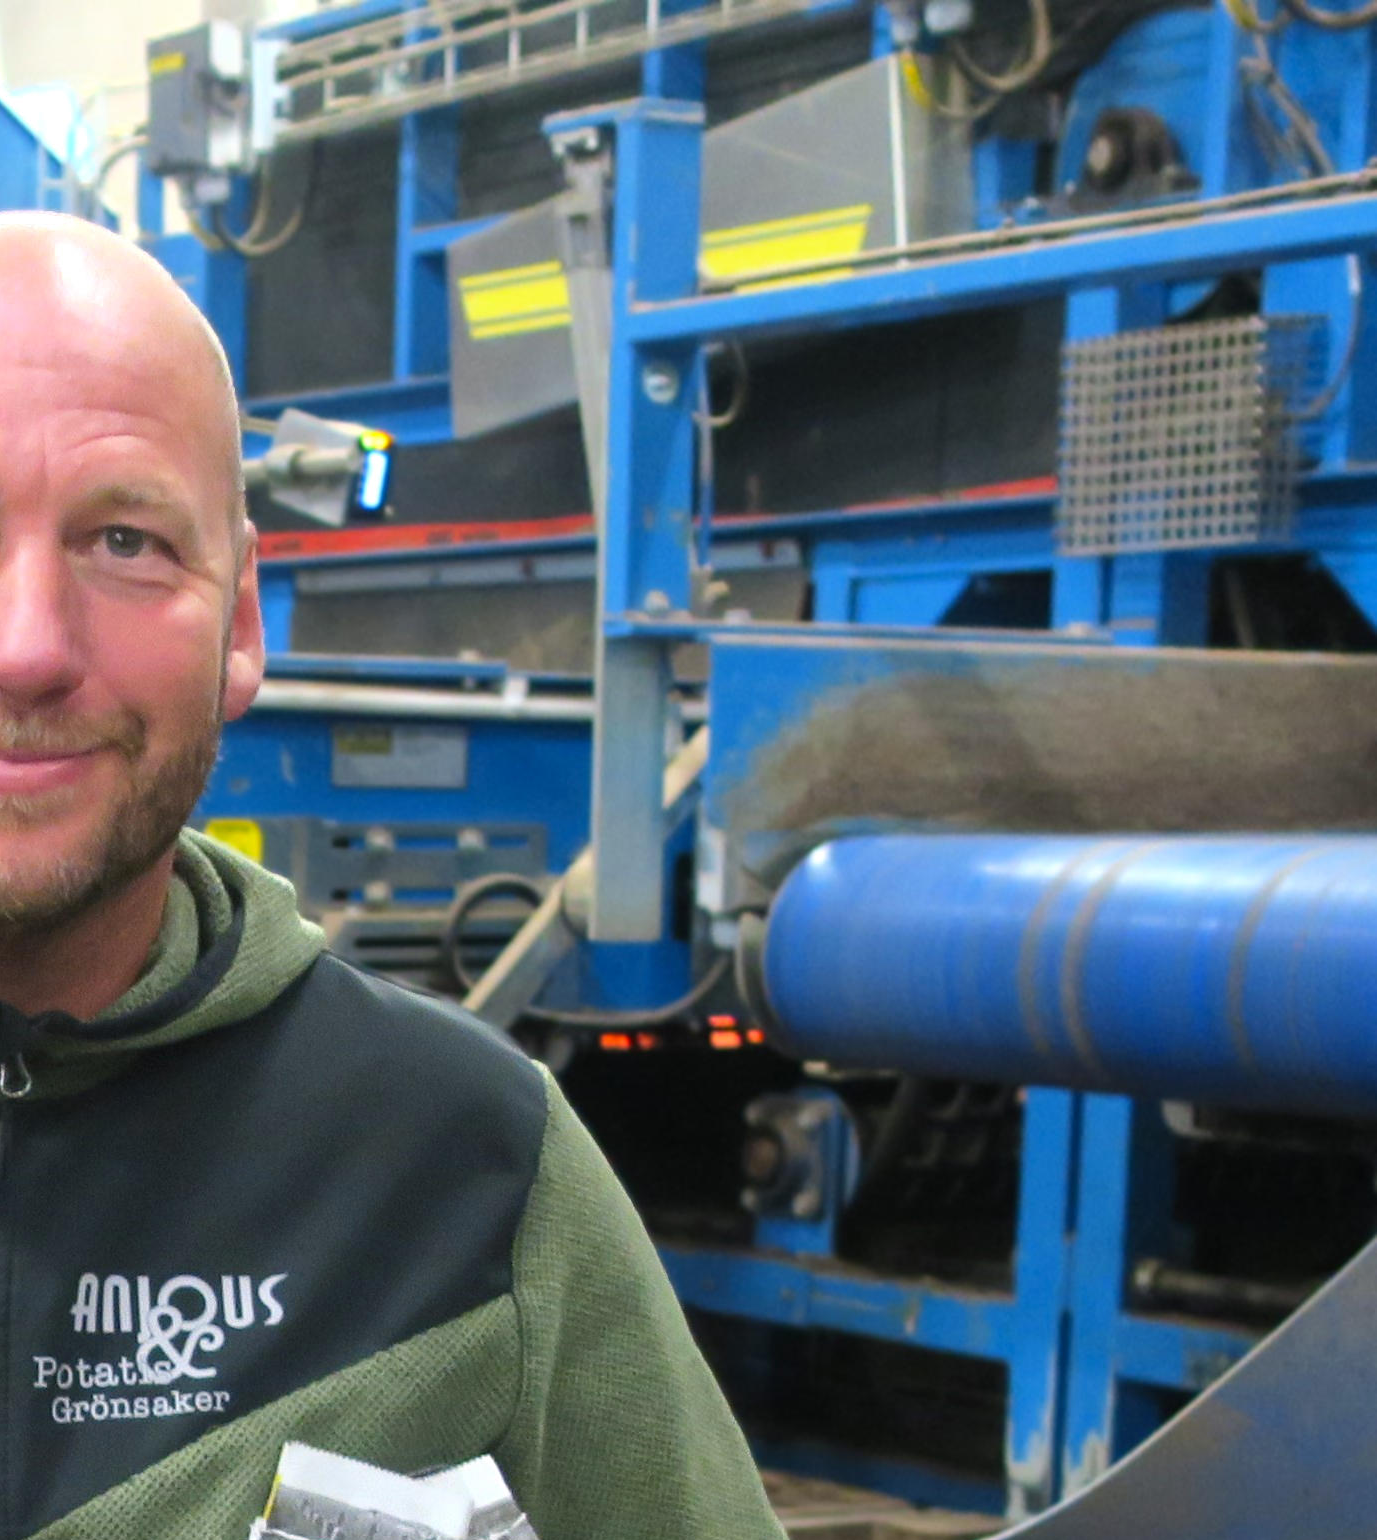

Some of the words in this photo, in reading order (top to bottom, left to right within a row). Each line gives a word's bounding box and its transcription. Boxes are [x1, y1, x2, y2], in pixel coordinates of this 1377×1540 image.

[70, 1272, 289, 1344] ANJOUS
[32, 1355, 175, 1389] Potatis
[51, 1389, 231, 1424] Grönsaker
